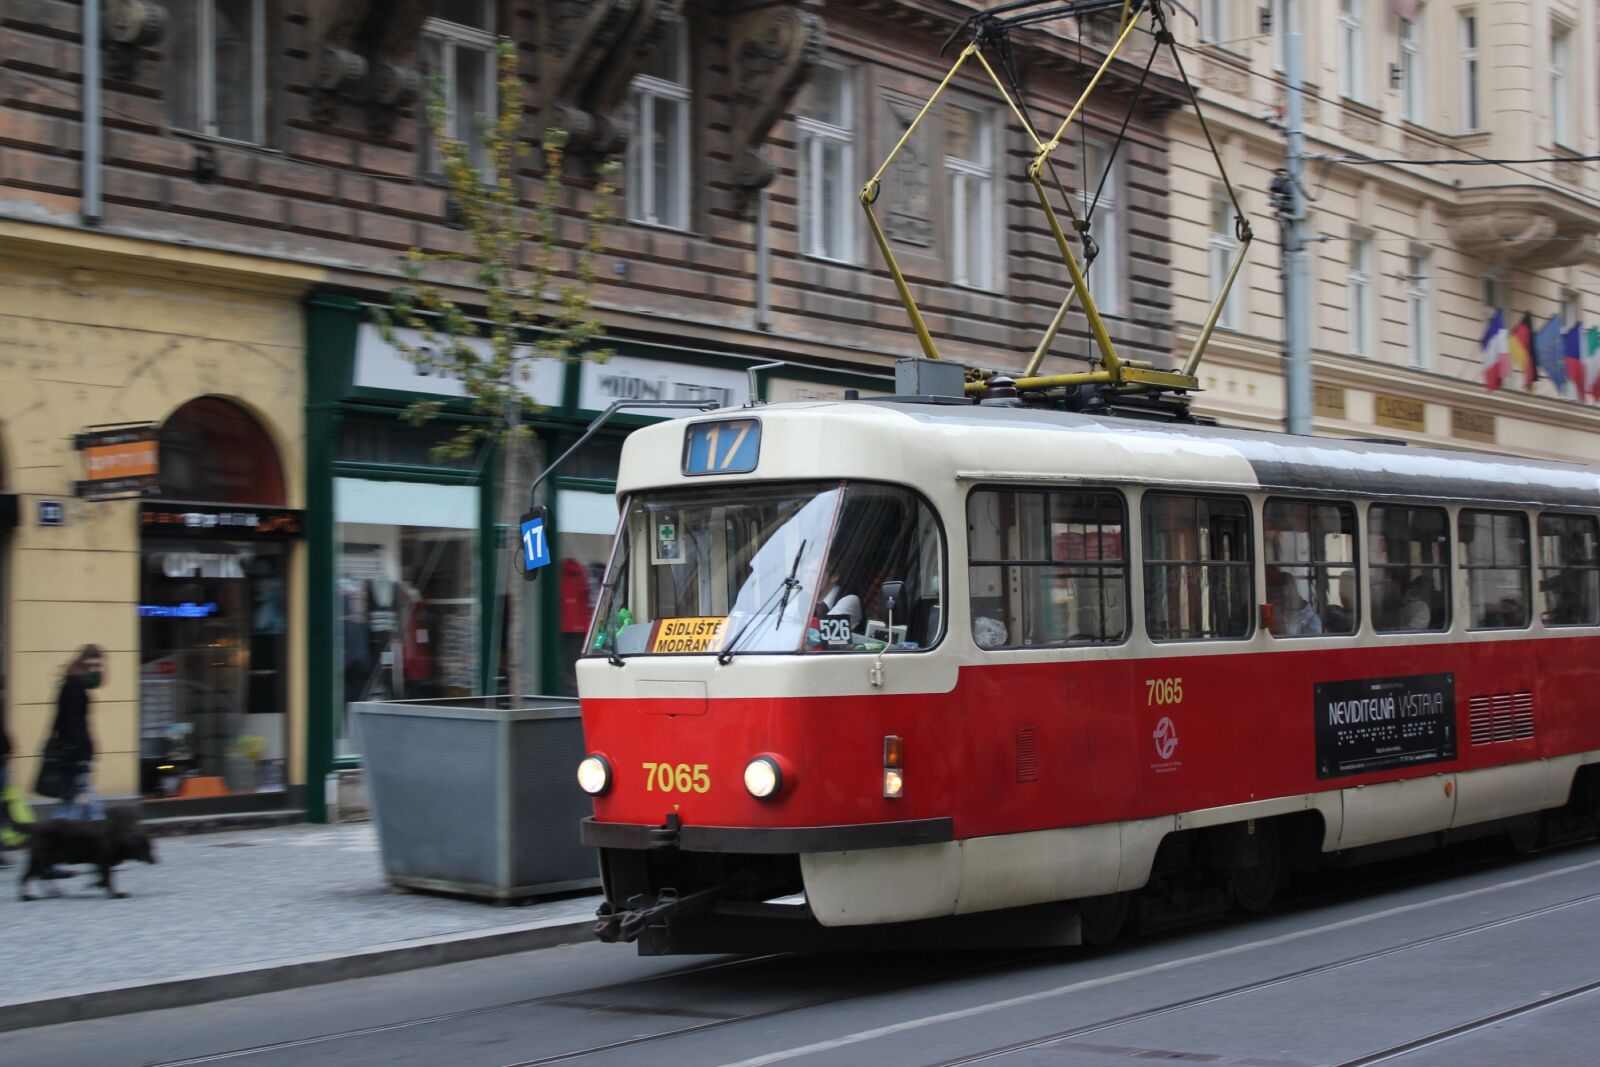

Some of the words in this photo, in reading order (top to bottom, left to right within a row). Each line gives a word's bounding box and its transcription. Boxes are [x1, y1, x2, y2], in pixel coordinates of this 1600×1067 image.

[705, 421, 753, 470] 17
[523, 525, 544, 561] 17
[664, 620, 722, 637] SÍDLIŠTĚ
[819, 619, 850, 641] 526
[1146, 677, 1183, 706] 7065
[642, 762, 711, 793] 7065
